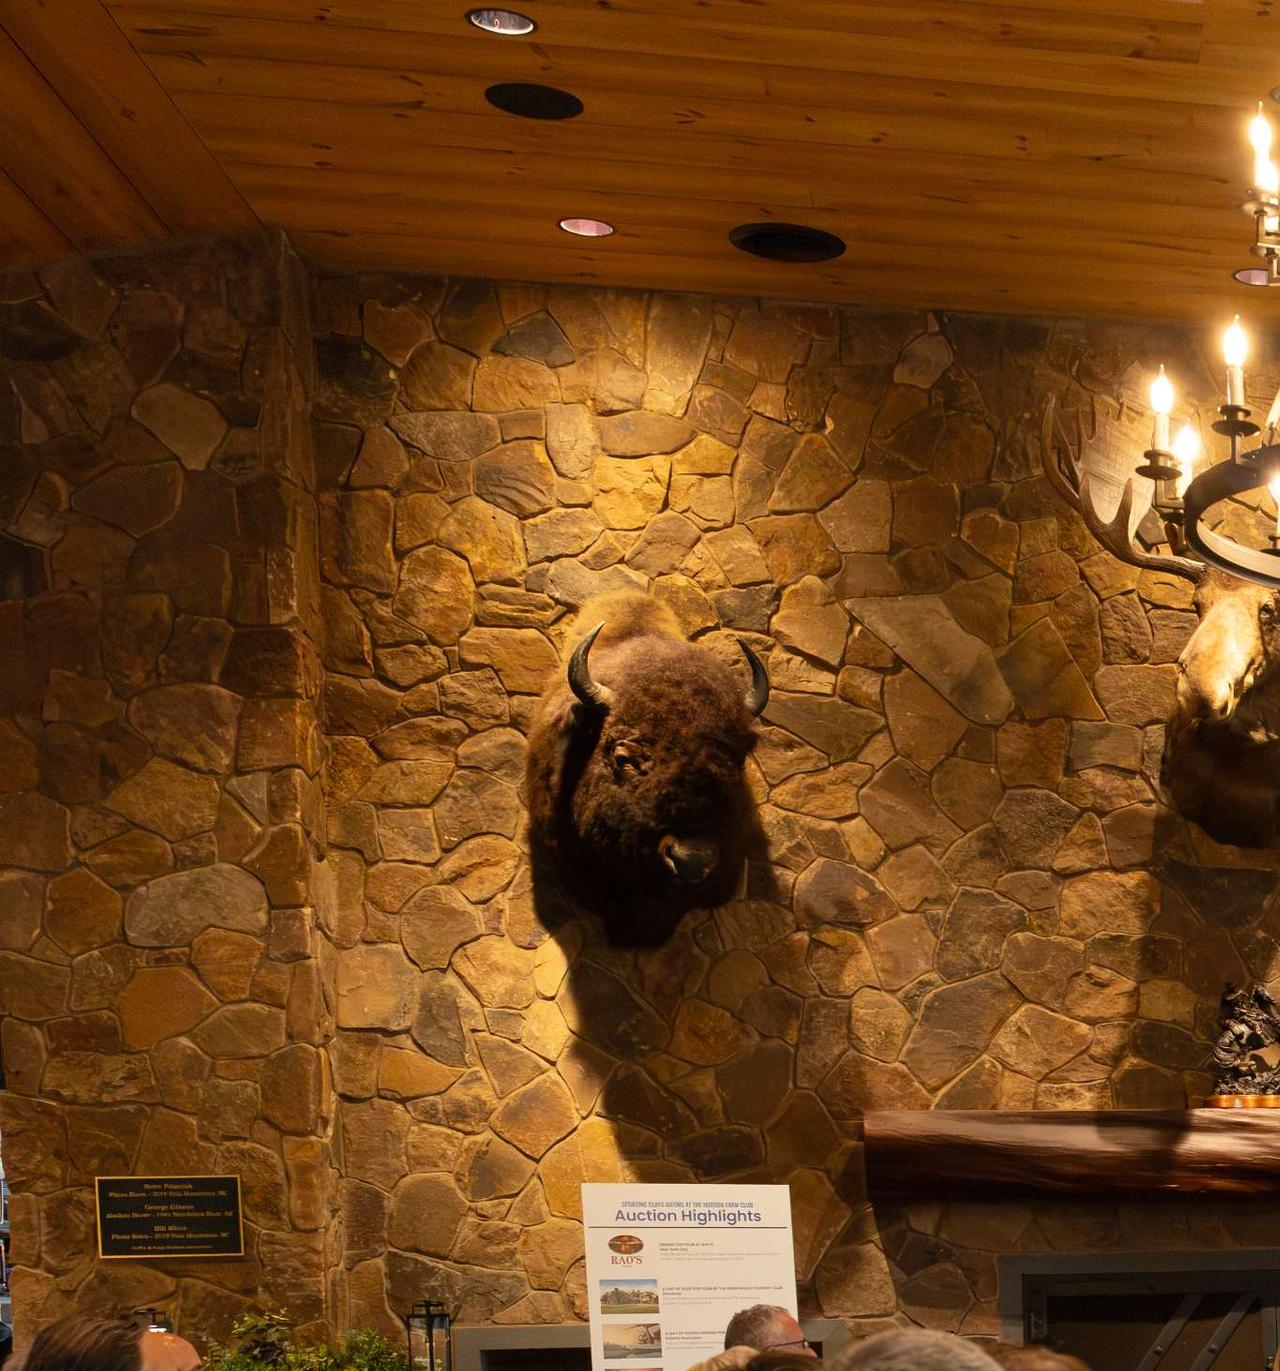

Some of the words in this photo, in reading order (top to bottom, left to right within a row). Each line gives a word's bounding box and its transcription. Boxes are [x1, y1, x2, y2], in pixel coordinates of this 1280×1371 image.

[615, 1208, 677, 1222] Auction
[681, 1208, 762, 1226] Highlights
[611, 1255, 643, 1265] RAO'S
